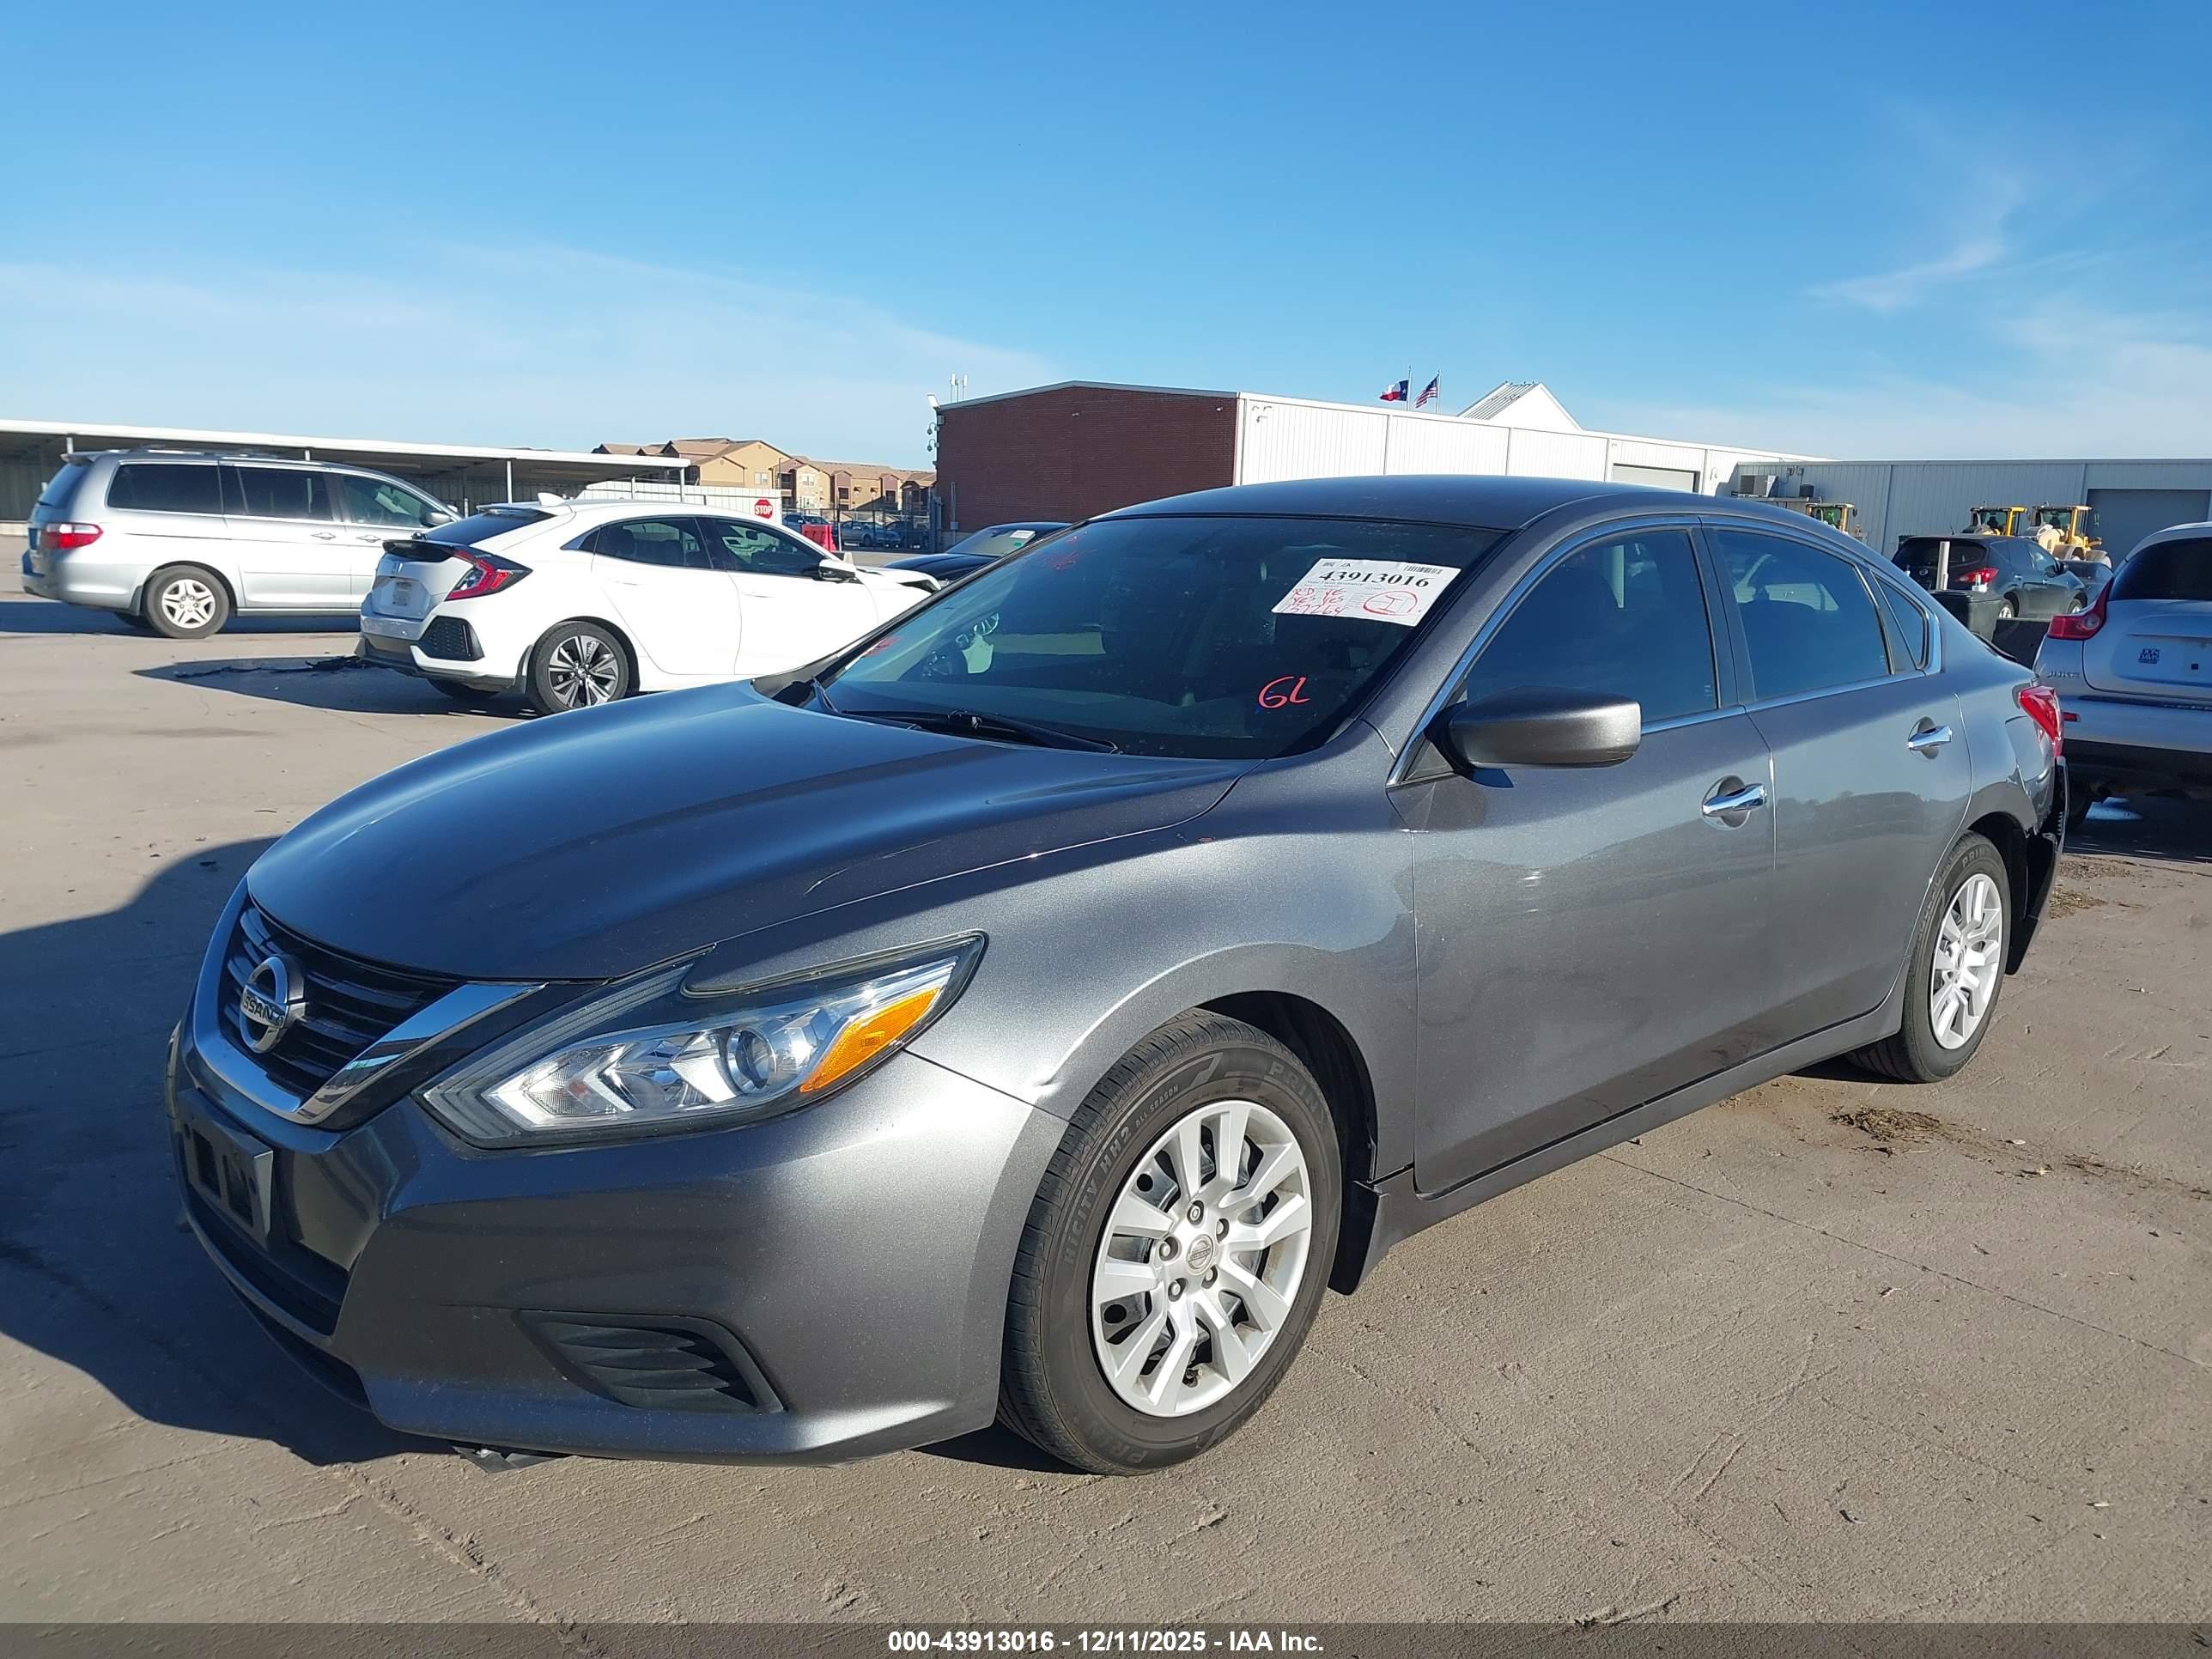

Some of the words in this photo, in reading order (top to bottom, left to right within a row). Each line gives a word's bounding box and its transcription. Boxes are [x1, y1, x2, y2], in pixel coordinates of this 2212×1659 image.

[756, 505, 773, 514] STOP
[1319, 570, 1434, 587] 43913016
[1150, 1085, 1178, 1113] SEASON
